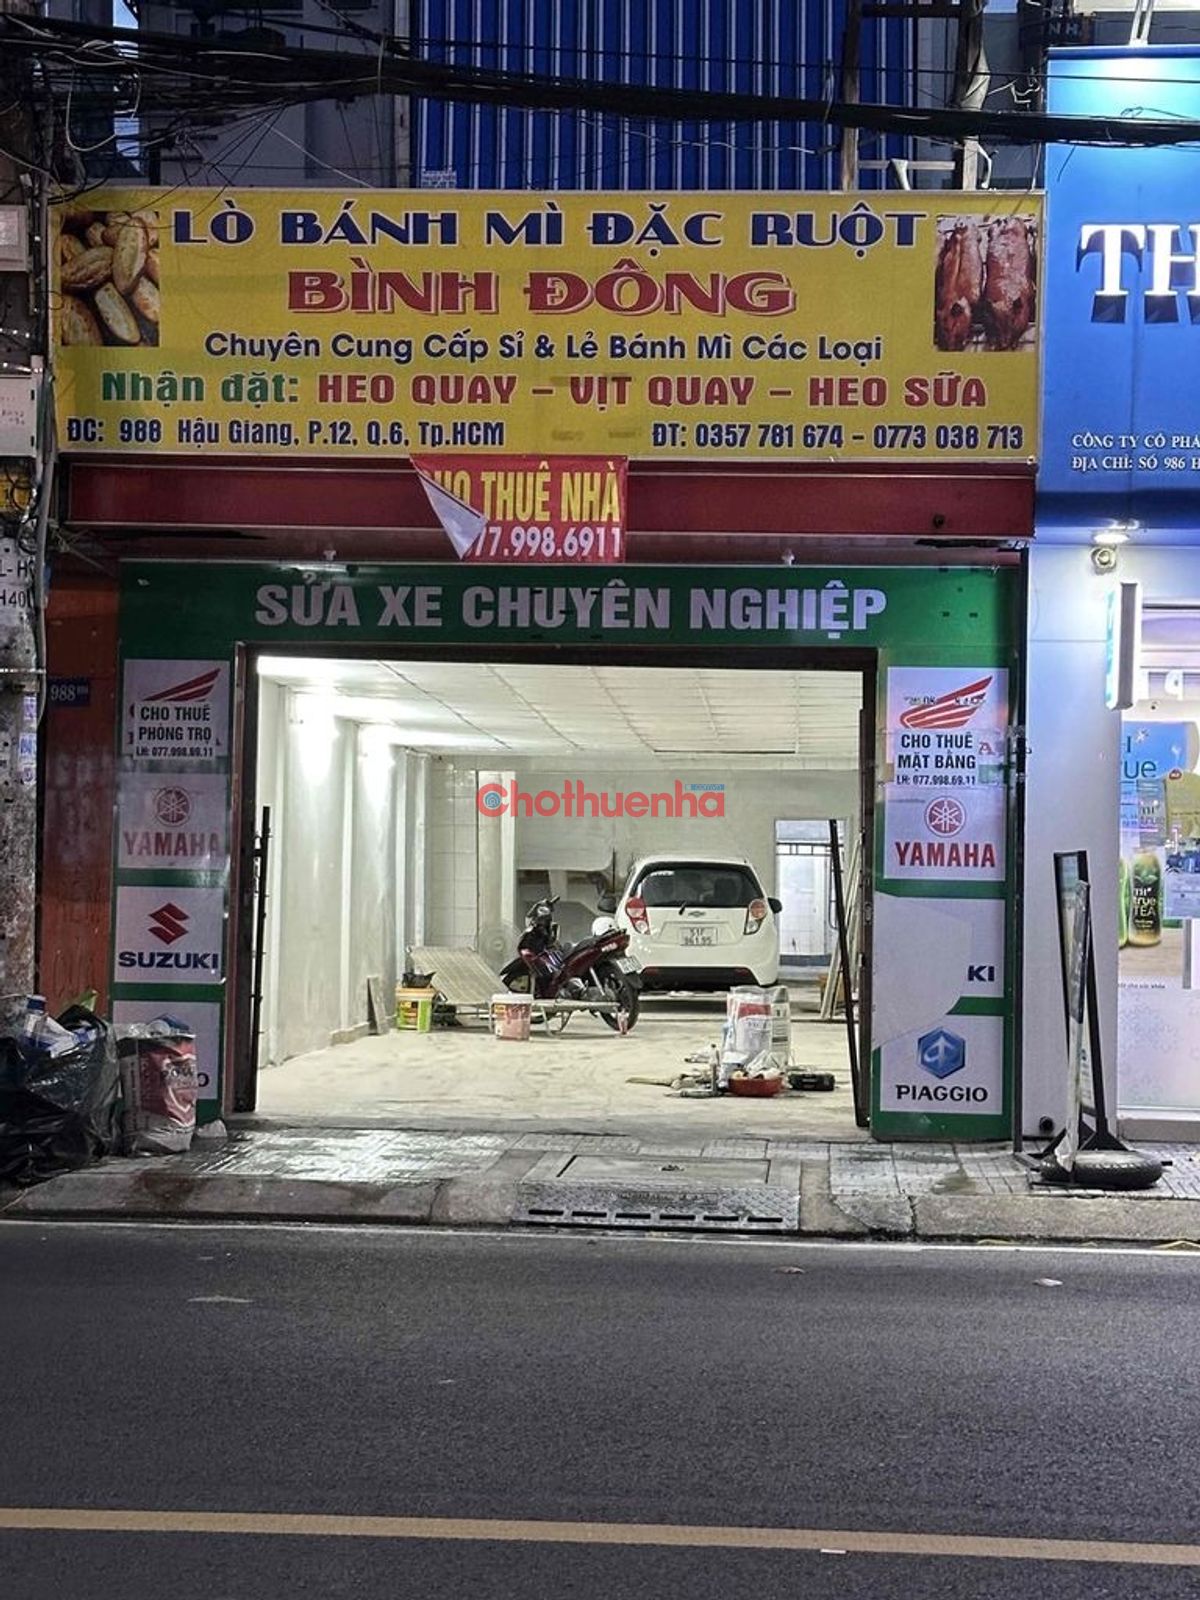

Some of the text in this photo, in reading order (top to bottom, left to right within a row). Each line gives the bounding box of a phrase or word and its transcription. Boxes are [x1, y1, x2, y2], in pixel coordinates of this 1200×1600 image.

[173, 200, 926, 257] LÒ BÁNH MÌ ĐẶC RUỘT
[1080, 223, 1200, 295] TH
[287, 257, 796, 317] BÌNH ĐÔNG
[205, 328, 882, 367] Chuyên Cung Cấp Sỉ & Lẻ Bánh Mì Các Loại
[102, 370, 205, 407] Nhận
[221, 370, 299, 408] đặt:
[318, 374, 396, 404] HEO
[411, 374, 517, 406] QUAY
[569, 375, 633, 411] VỊT
[648, 376, 755, 408] QUAY
[808, 376, 888, 408] HEO
[904, 371, 987, 408] SỮA
[67, 416, 505, 448] ĐC: 988 Hậu Giang, P.12, Q.6, Tp.HCM
[652, 423, 687, 448] ĐT:
[695, 423, 749, 448] 0357
[758, 424, 794, 448] 781
[802, 424, 844, 449] 674
[873, 424, 926, 449] 0773
[935, 425, 979, 449] 038
[987, 425, 1023, 450] 713
[1072, 431, 1114, 448] CÔNG
[1119, 435, 1139, 448] TY
[1072, 456, 1098, 472] ĐỊA
[1164, 456, 1186, 470] 986
[480, 460, 551, 522] THUÊ
[560, 461, 621, 523] NHÀ
[466, 525, 621, 558] 77.998.6911
[255, 571, 888, 639] SỬA XE CHUYÊN NGHIỆP
[50, 684, 77, 701] 988
[140, 706, 170, 721] CHO
[187, 726, 212, 744] TRỌ
[901, 733, 931, 748] CHO
[935, 732, 973, 748] THUÊ
[898, 749, 976, 771] MẶT BẰNG
[896, 775, 976, 785] LH: 077.998.69.11
[123, 831, 221, 857] YAMAHA
[895, 840, 996, 868] YAMAHA
[118, 950, 219, 969] SUZUKI
[895, 1083, 989, 1104] PIAGGIO
